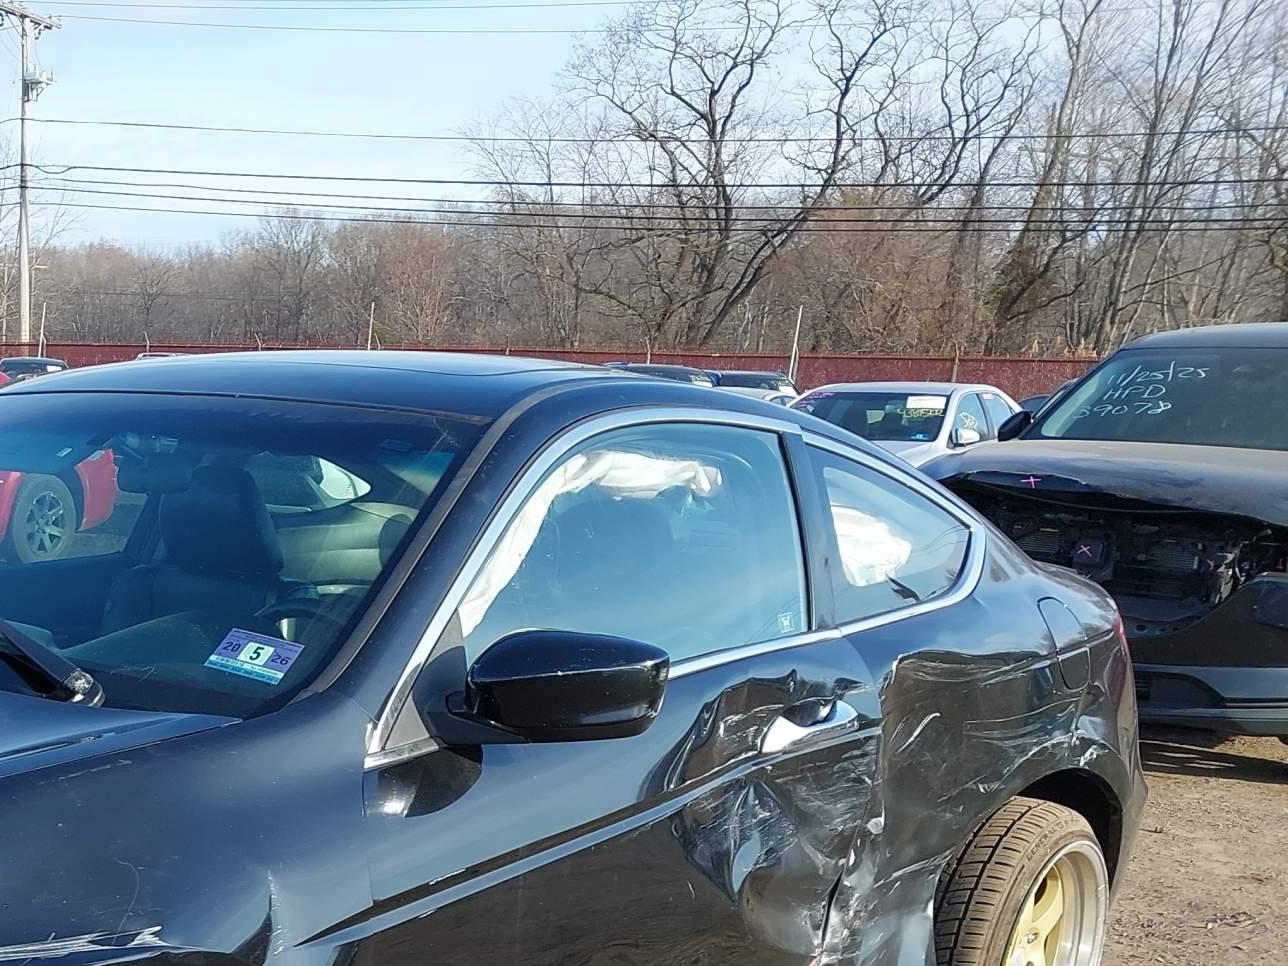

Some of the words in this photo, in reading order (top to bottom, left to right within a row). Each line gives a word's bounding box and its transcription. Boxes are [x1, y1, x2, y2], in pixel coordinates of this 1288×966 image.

[1107, 361, 1211, 387] 11/25/25
[1073, 400, 1172, 419] 39078
[223, 641, 241, 653] 20
[249, 646, 264, 661] 5
[271, 654, 291, 666] 26
